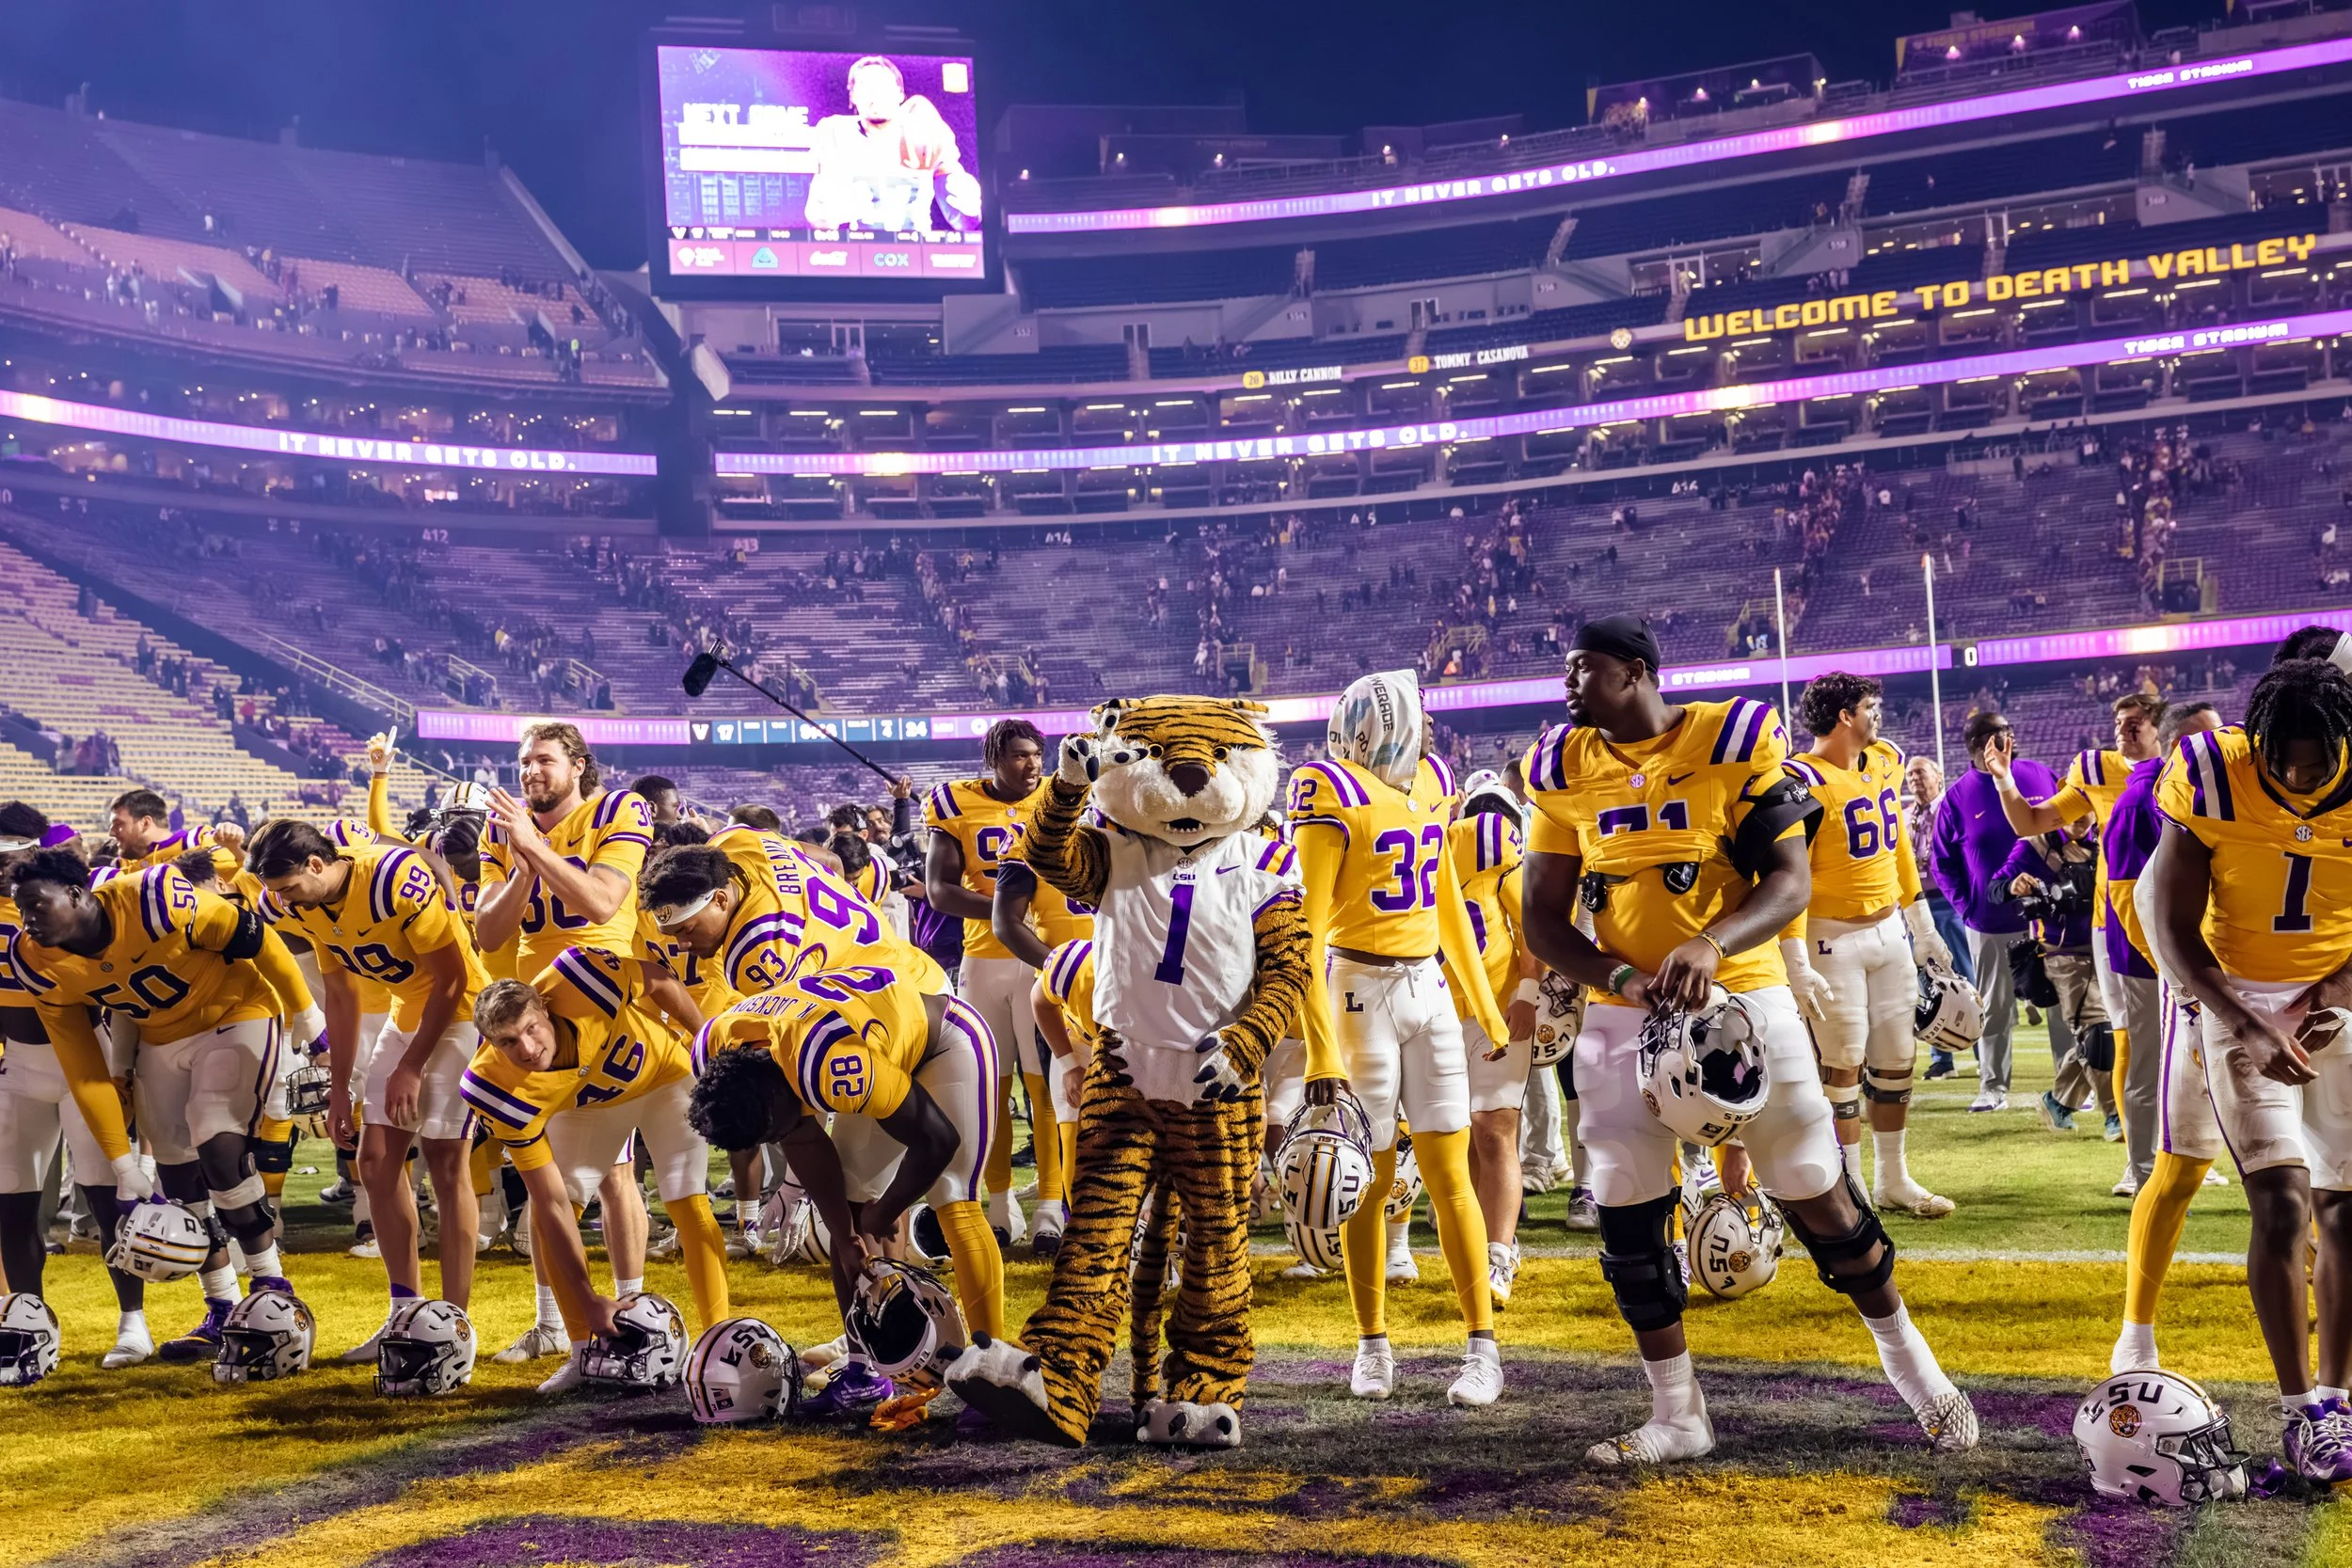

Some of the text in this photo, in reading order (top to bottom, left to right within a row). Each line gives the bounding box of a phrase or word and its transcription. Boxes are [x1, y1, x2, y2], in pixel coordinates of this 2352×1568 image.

[2128, 59, 2253, 89] TIGER STADIUM
[1373, 161, 1616, 207] IT NEVER GETS OLD.
[873, 252, 909, 267] COX
[1685, 233, 2316, 341] WELCOME TO DEATH VALLEY
[2123, 323, 2289, 355] TIGER STADIUM
[1413, 345, 1529, 371] 37 TOMMY CASANOVA
[1268, 368, 1296, 385] BILLY
[1300, 366, 1342, 383] CANNON
[278, 432, 577, 470] IT NEVER GETS OLD.
[1152, 423, 1469, 463] IT NEVER GETS OLD.
[422, 528, 449, 544] 412
[1350, 512, 1376, 526] 45
[1367, 675, 1394, 732] WERADE
[717, 724, 735, 741] 17
[905, 721, 928, 737] 24
[1288, 778, 1318, 812] 32
[1630, 773, 1645, 788] SEC
[1842, 787, 1899, 860] 66
[2295, 825, 2313, 843] SEC
[1172, 872, 1197, 881] LSU
[1178, 857, 1194, 868] SEC
[1370, 823, 1444, 912] 32
[171, 878, 196, 913] 50
[400, 864, 431, 904] 99
[2272, 851, 2314, 934] 1
[1153, 883, 1195, 986] 1
[1818, 941, 1833, 956] L
[745, 947, 787, 990] 93
[85, 964, 191, 1020] 50
[730, 995, 800, 1017] JACKSON
[1343, 991, 1365, 1014] L
[575, 1034, 645, 1109] 46
[119, 1219, 135, 1260] TIGERS
[1708, 1234, 1737, 1291] LSU
[889, 1349, 931, 1380] TIGERS
[2083, 1381, 2164, 1424] LSU
